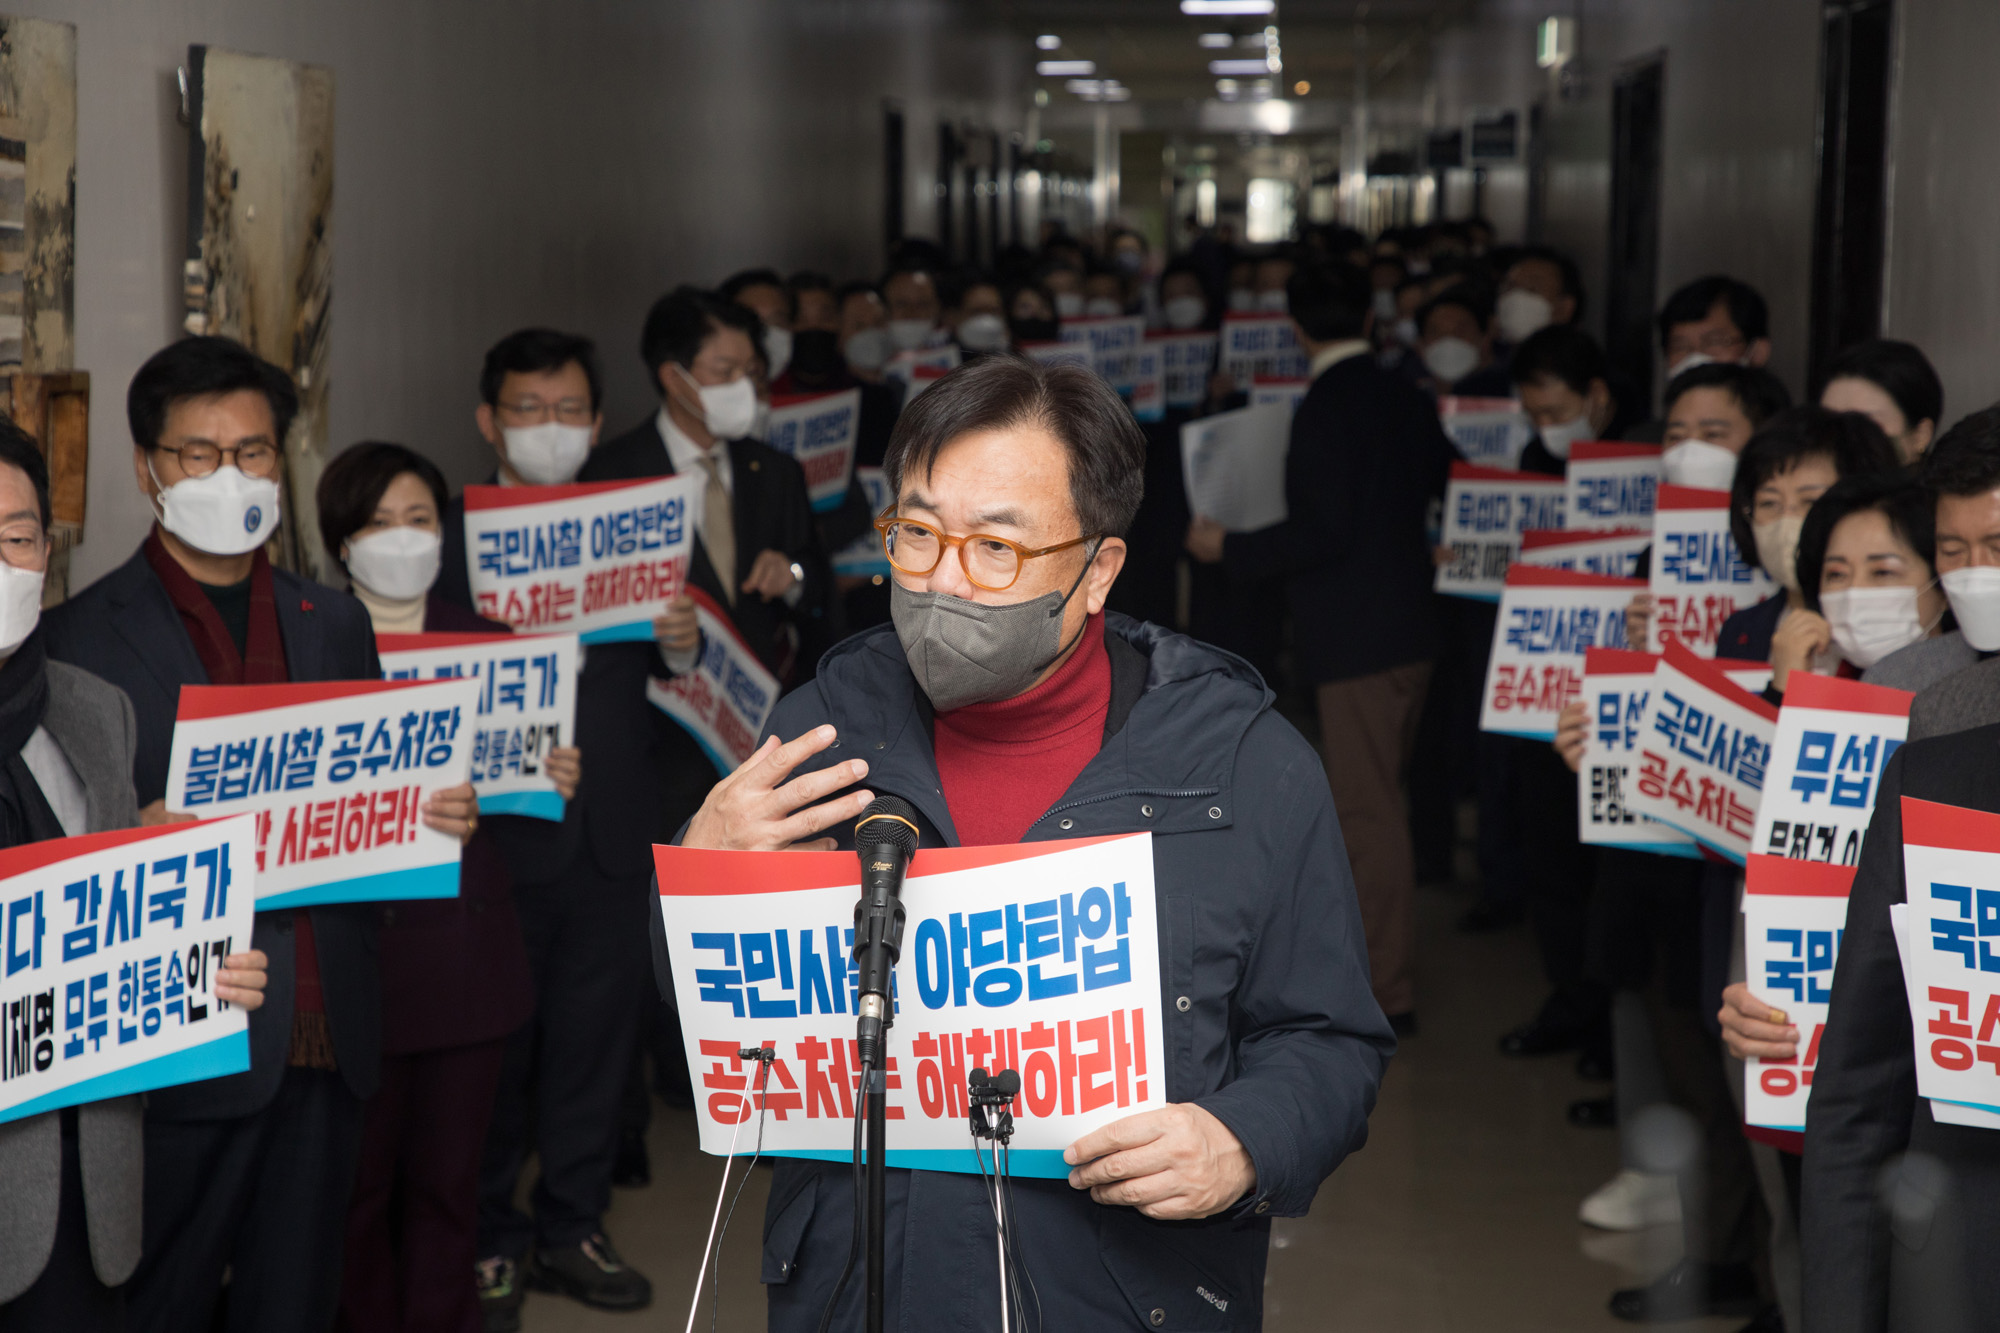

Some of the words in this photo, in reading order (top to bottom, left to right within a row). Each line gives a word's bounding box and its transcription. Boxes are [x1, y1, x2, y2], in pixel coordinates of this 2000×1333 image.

[478, 518, 583, 578] 국민사찰
[590, 496, 685, 560] 야당탄압
[1506, 607, 1599, 656] 국민사찰
[1657, 593, 1737, 646] 공수처
[1493, 664, 1583, 714] 공수처는
[183, 726, 325, 808] 불법사찰
[327, 705, 461, 784] 공수처장
[1654, 690, 1771, 792] 국민사찰
[277, 785, 421, 867] 사퇴하라!
[1638, 749, 1754, 842] 공수처는
[62, 841, 232, 964] 감시국가
[915, 881, 1132, 1010] 야당탄압
[63, 971, 109, 1061] 모두
